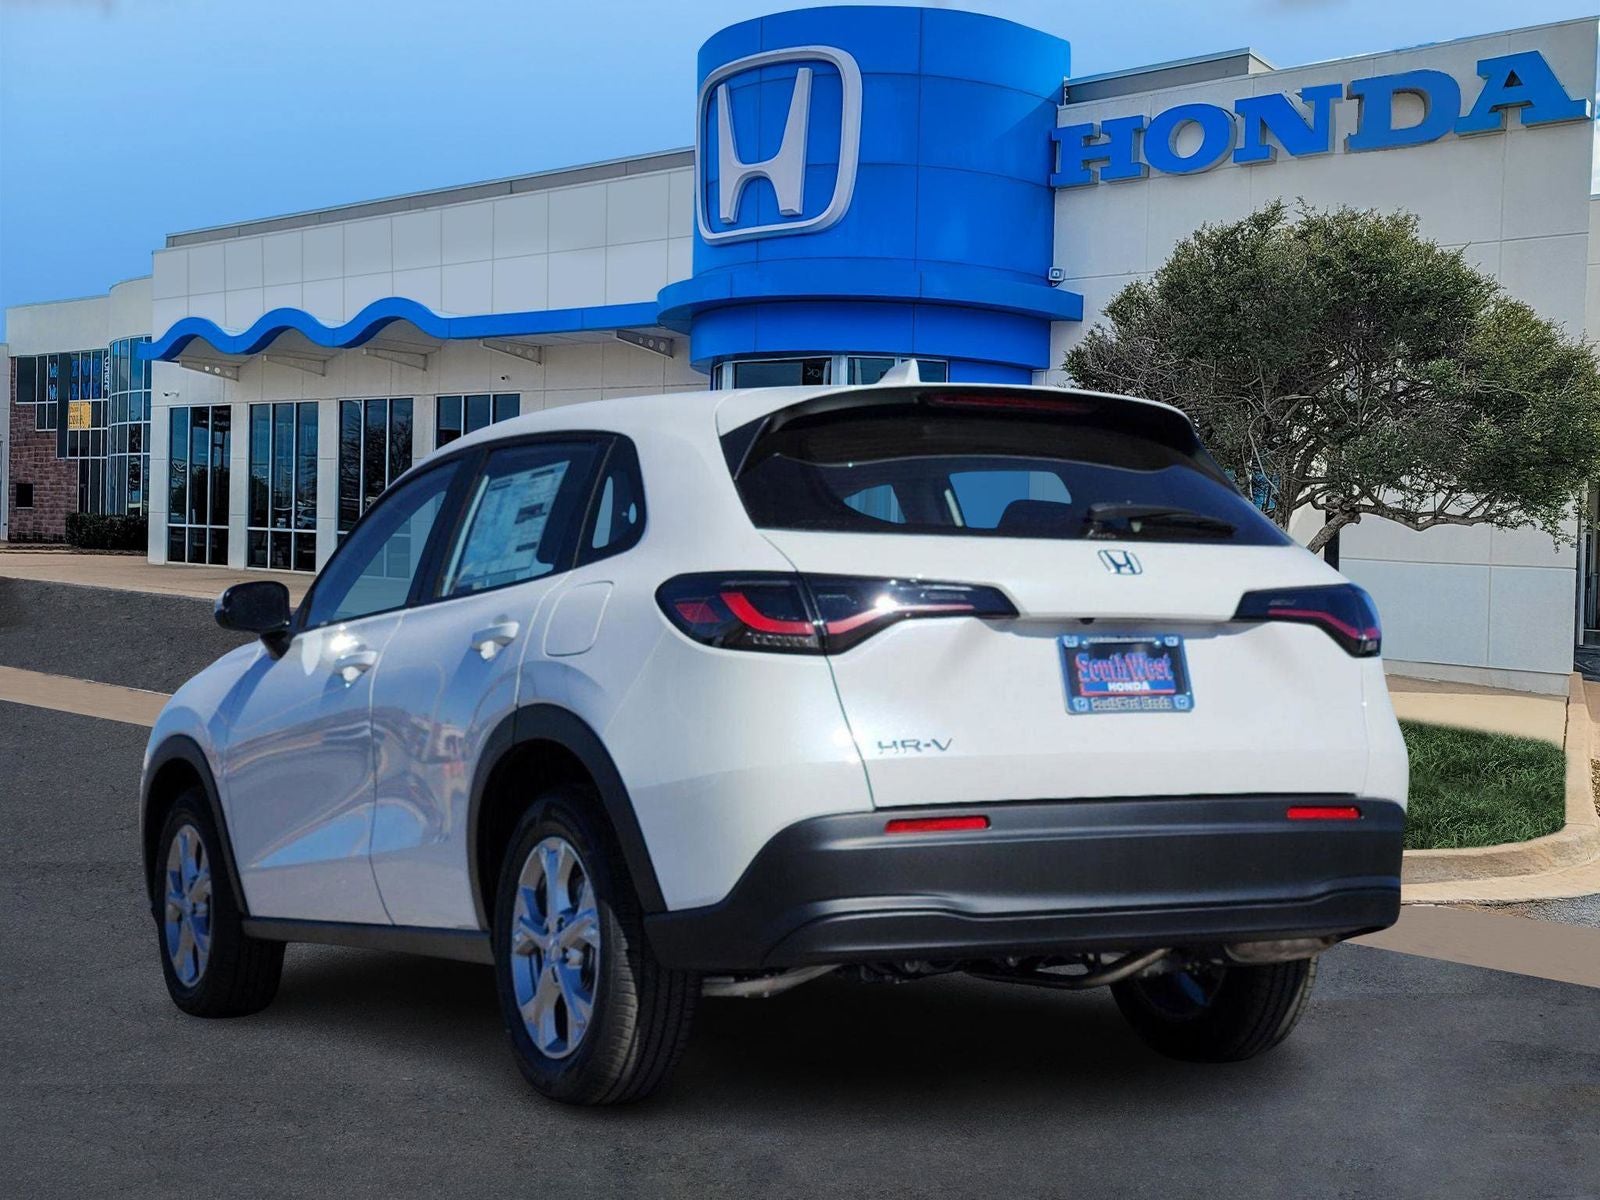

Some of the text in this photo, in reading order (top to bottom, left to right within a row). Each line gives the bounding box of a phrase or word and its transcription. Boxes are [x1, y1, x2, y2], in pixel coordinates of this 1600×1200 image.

[1050, 49, 1592, 189] HONDA
[1107, 682, 1150, 692] HONDA
[877, 737, 953, 754] HR-V
